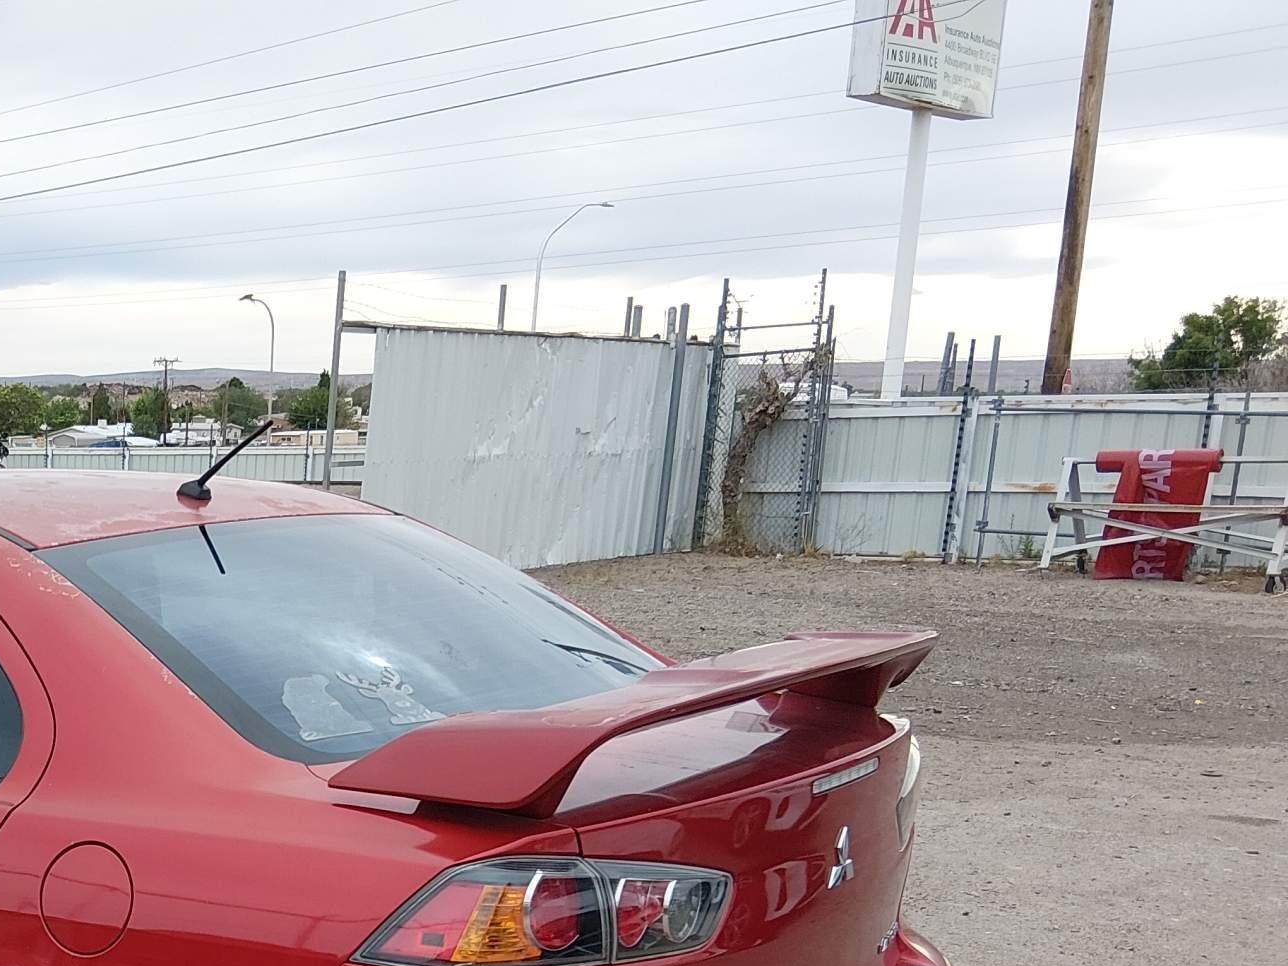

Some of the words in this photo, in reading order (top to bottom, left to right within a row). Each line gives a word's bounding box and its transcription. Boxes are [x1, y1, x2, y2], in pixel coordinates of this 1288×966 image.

[886, 48, 938, 69] INSURANCE
[884, 70, 905, 85] AUTO
[904, 73, 937, 90] AUCTIONS
